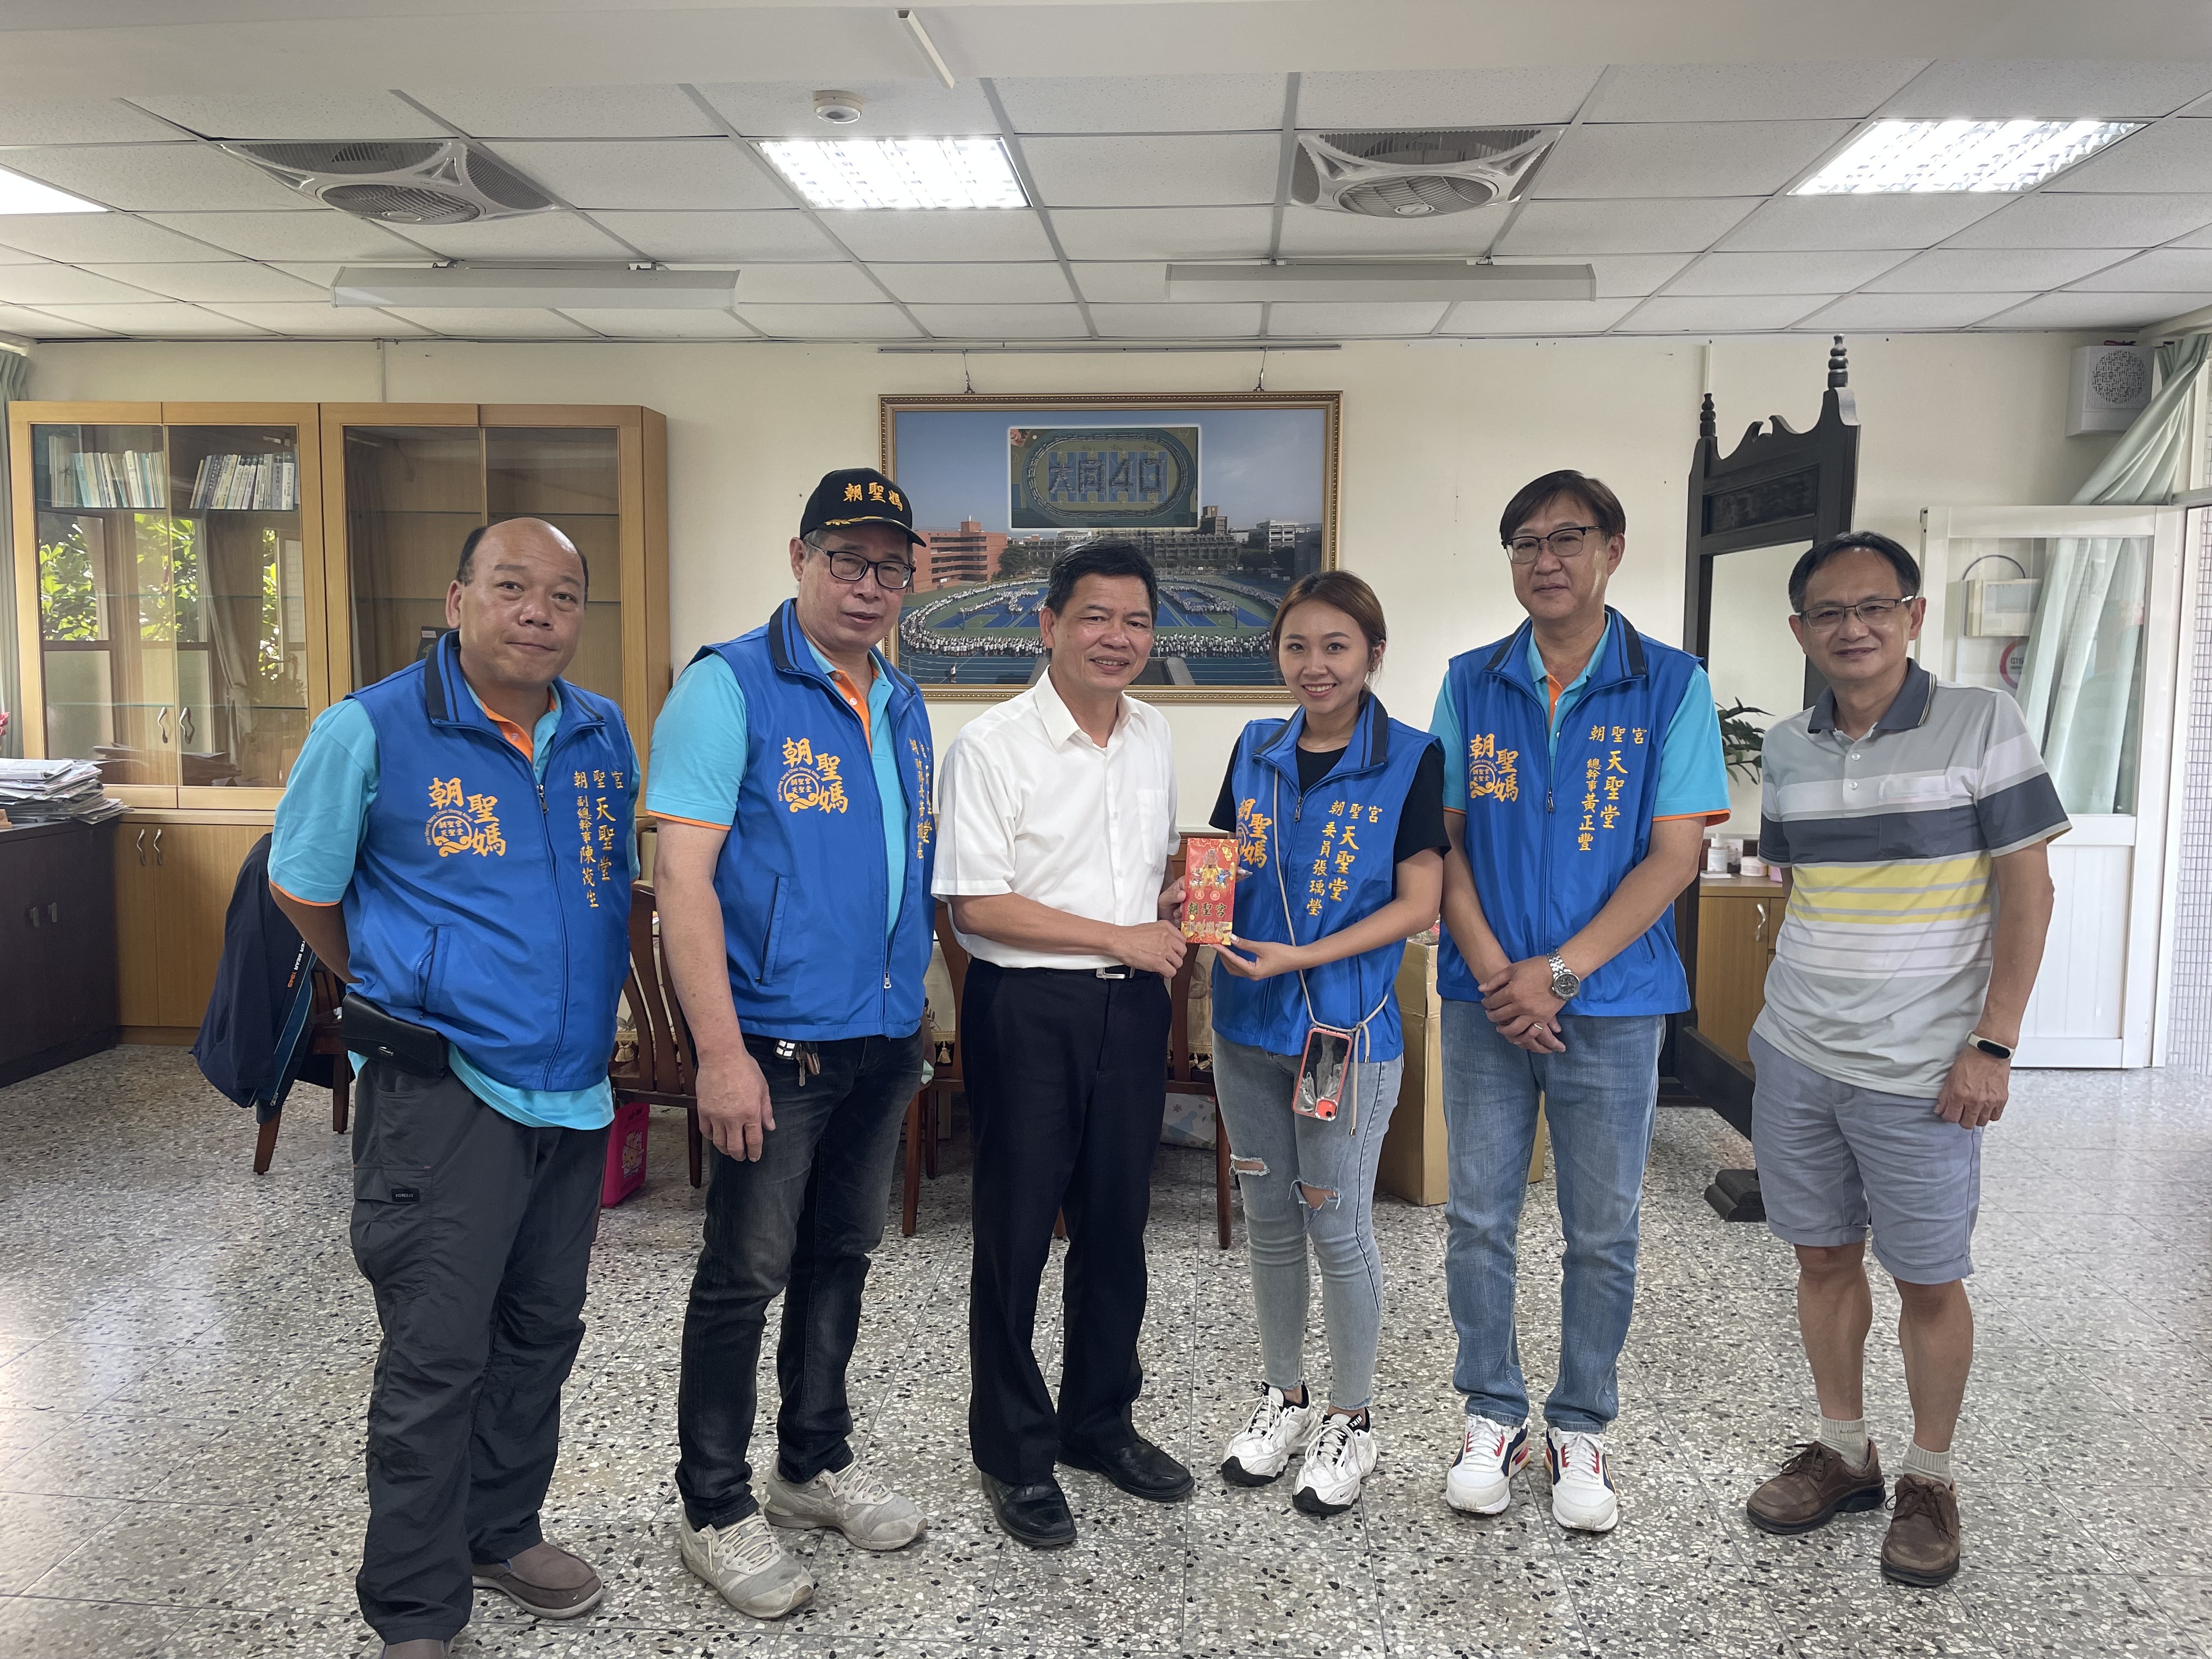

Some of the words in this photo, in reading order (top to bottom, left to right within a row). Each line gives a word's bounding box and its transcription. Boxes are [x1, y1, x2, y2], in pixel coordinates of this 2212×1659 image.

[843, 482, 904, 512] 朝聖媽
[1588, 725, 1647, 744] 朝聖宮
[573, 769, 624, 789] 朝聖宮
[782, 737, 849, 814] 朝聖媽
[1469, 733, 1519, 803] 朝聖媽
[1600, 750, 1629, 829] 天聖堂
[428, 777, 506, 857] 朝聖媽
[1328, 800, 1383, 823] 朝聖宮
[596, 797, 617, 881] 天聖堂
[1328, 826, 1359, 902] 天聖堂
[1187, 901, 1227, 918] 朝聖宮
[1350, 1414, 1363, 1428] NIKE
